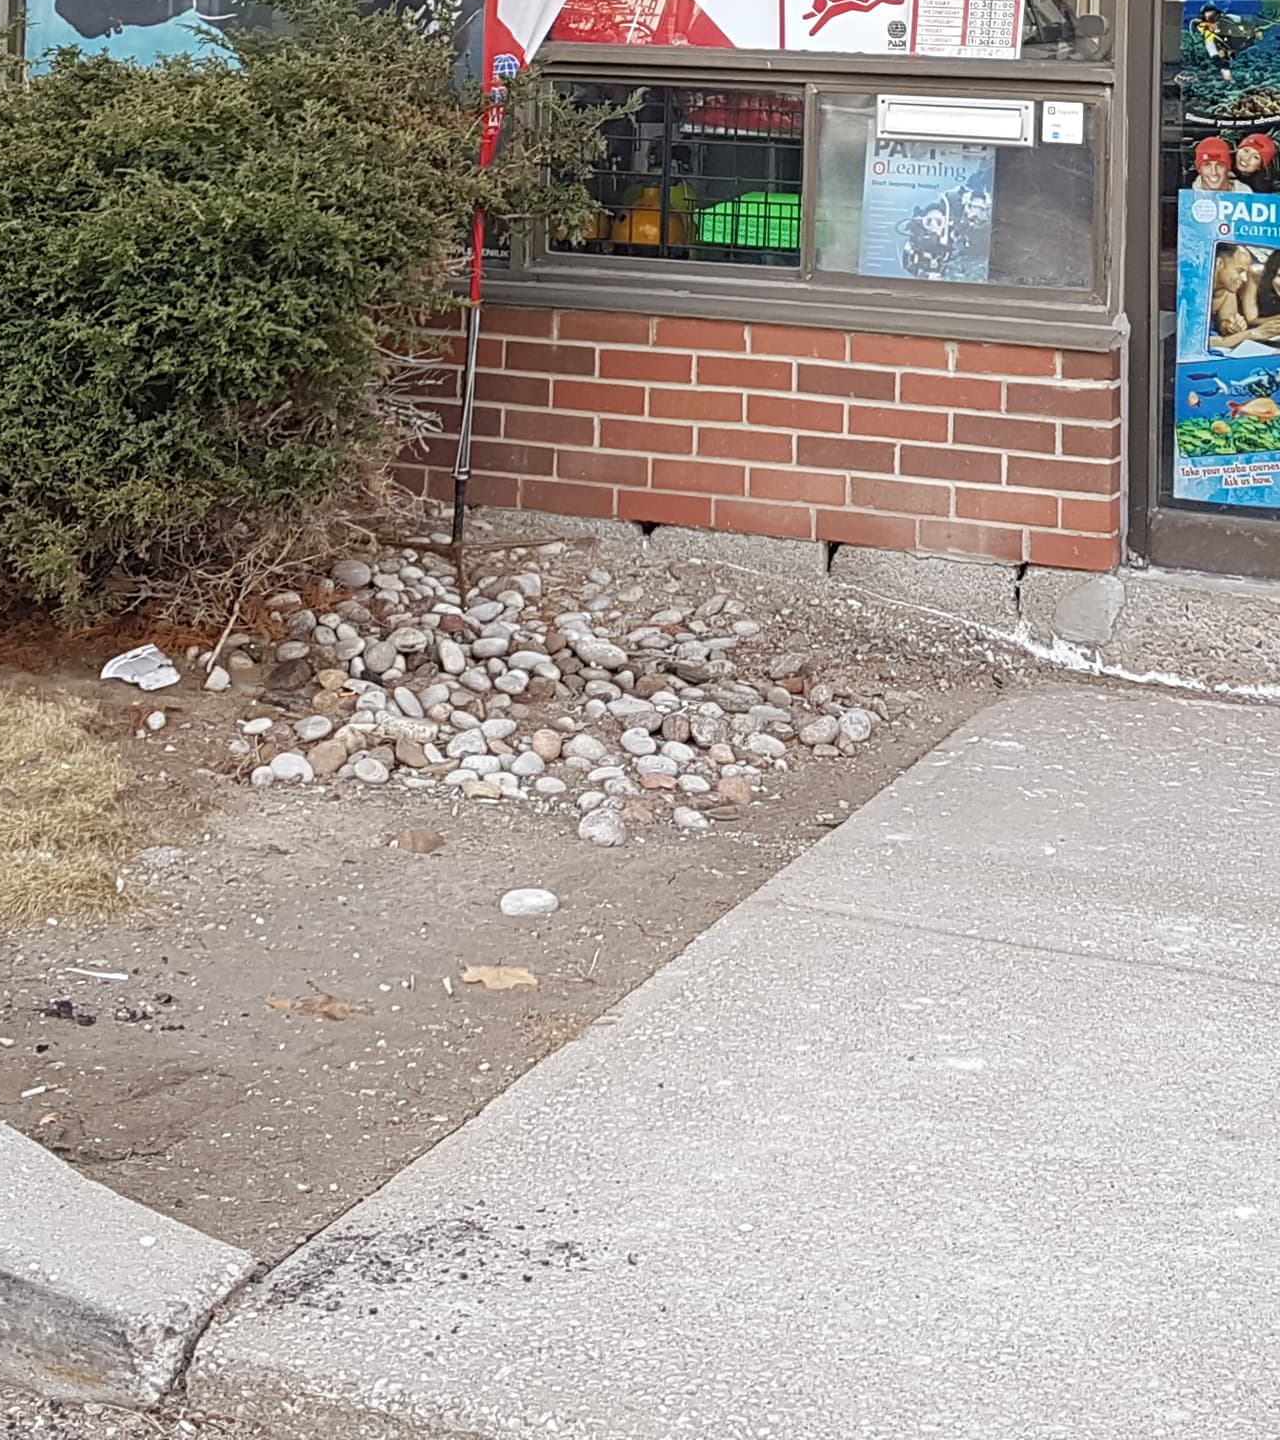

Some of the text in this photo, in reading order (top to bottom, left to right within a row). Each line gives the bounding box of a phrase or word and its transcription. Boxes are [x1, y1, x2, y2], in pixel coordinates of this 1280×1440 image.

[887, 39, 907, 48] PADI
[1185, 112, 1216, 125] Discover
[1218, 200, 1277, 224] PADI
[1181, 467, 1200, 477] Take
[1202, 468, 1220, 478] your
[1222, 464, 1247, 474] scuba
[1248, 463, 1280, 472] courses
[1223, 477, 1238, 487] Ask
